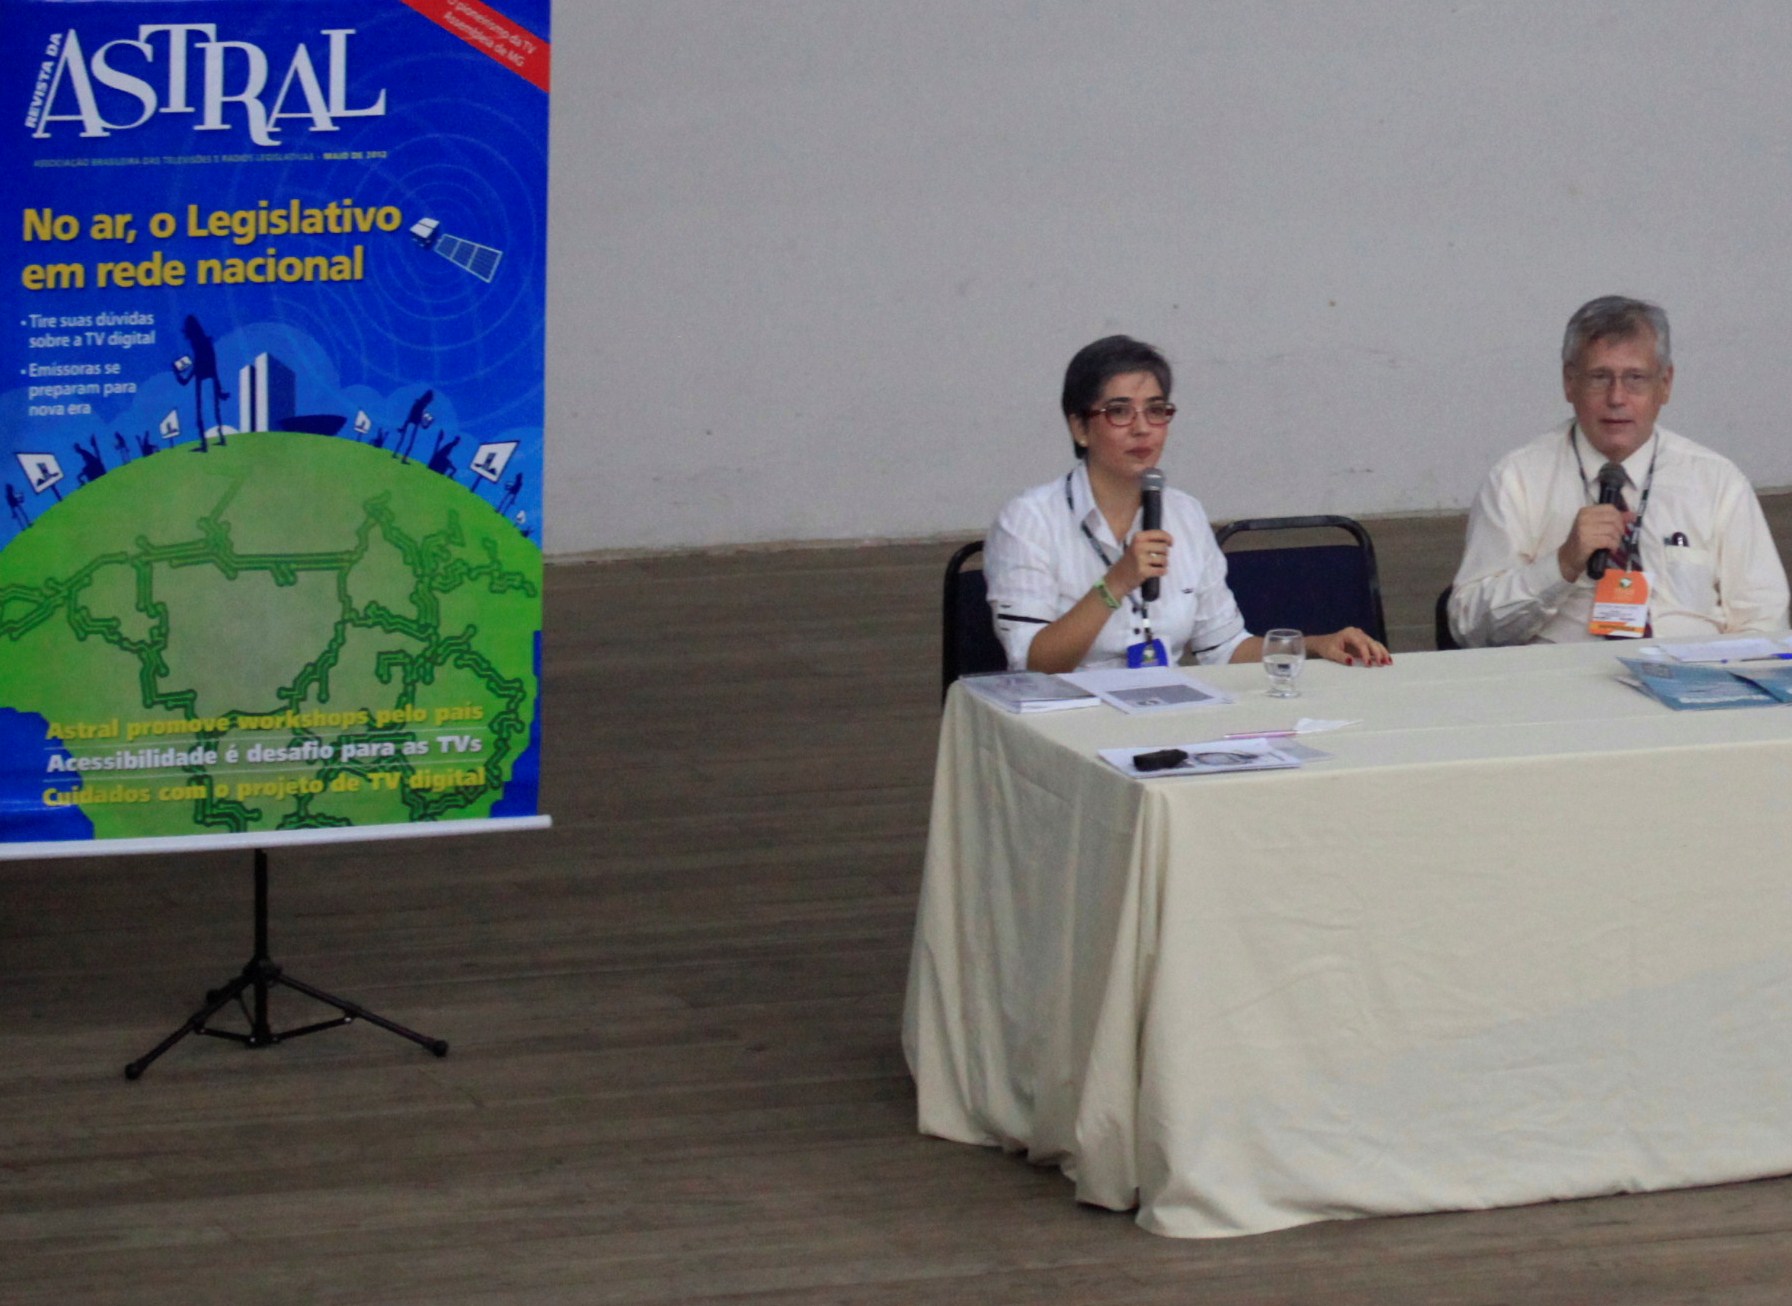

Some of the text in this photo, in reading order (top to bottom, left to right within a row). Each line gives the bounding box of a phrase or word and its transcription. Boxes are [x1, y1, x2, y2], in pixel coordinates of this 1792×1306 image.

[507, 50, 525, 67] MG
[522, 40, 538, 54] TV
[24, 33, 63, 128] REVISTA DA
[32, 23, 387, 146] ASTRAL
[23, 198, 403, 245] No ar, o Legislativo
[22, 244, 364, 290] em rede nacional
[28, 311, 155, 328] Tire suas dúvidas
[28, 330, 156, 349] sobre a TV digital
[28, 362, 121, 377] Emissoras se
[28, 382, 137, 400] preparam para
[28, 403, 92, 416] nova era
[45, 718, 120, 740] Astral
[127, 716, 230, 741] promove
[237, 709, 370, 730] workshops
[376, 704, 428, 728] pelo
[46, 735, 483, 773] Acessibilidade é desafio para as TVs
[43, 767, 487, 806] Cuidados com o projeto de TV digital
